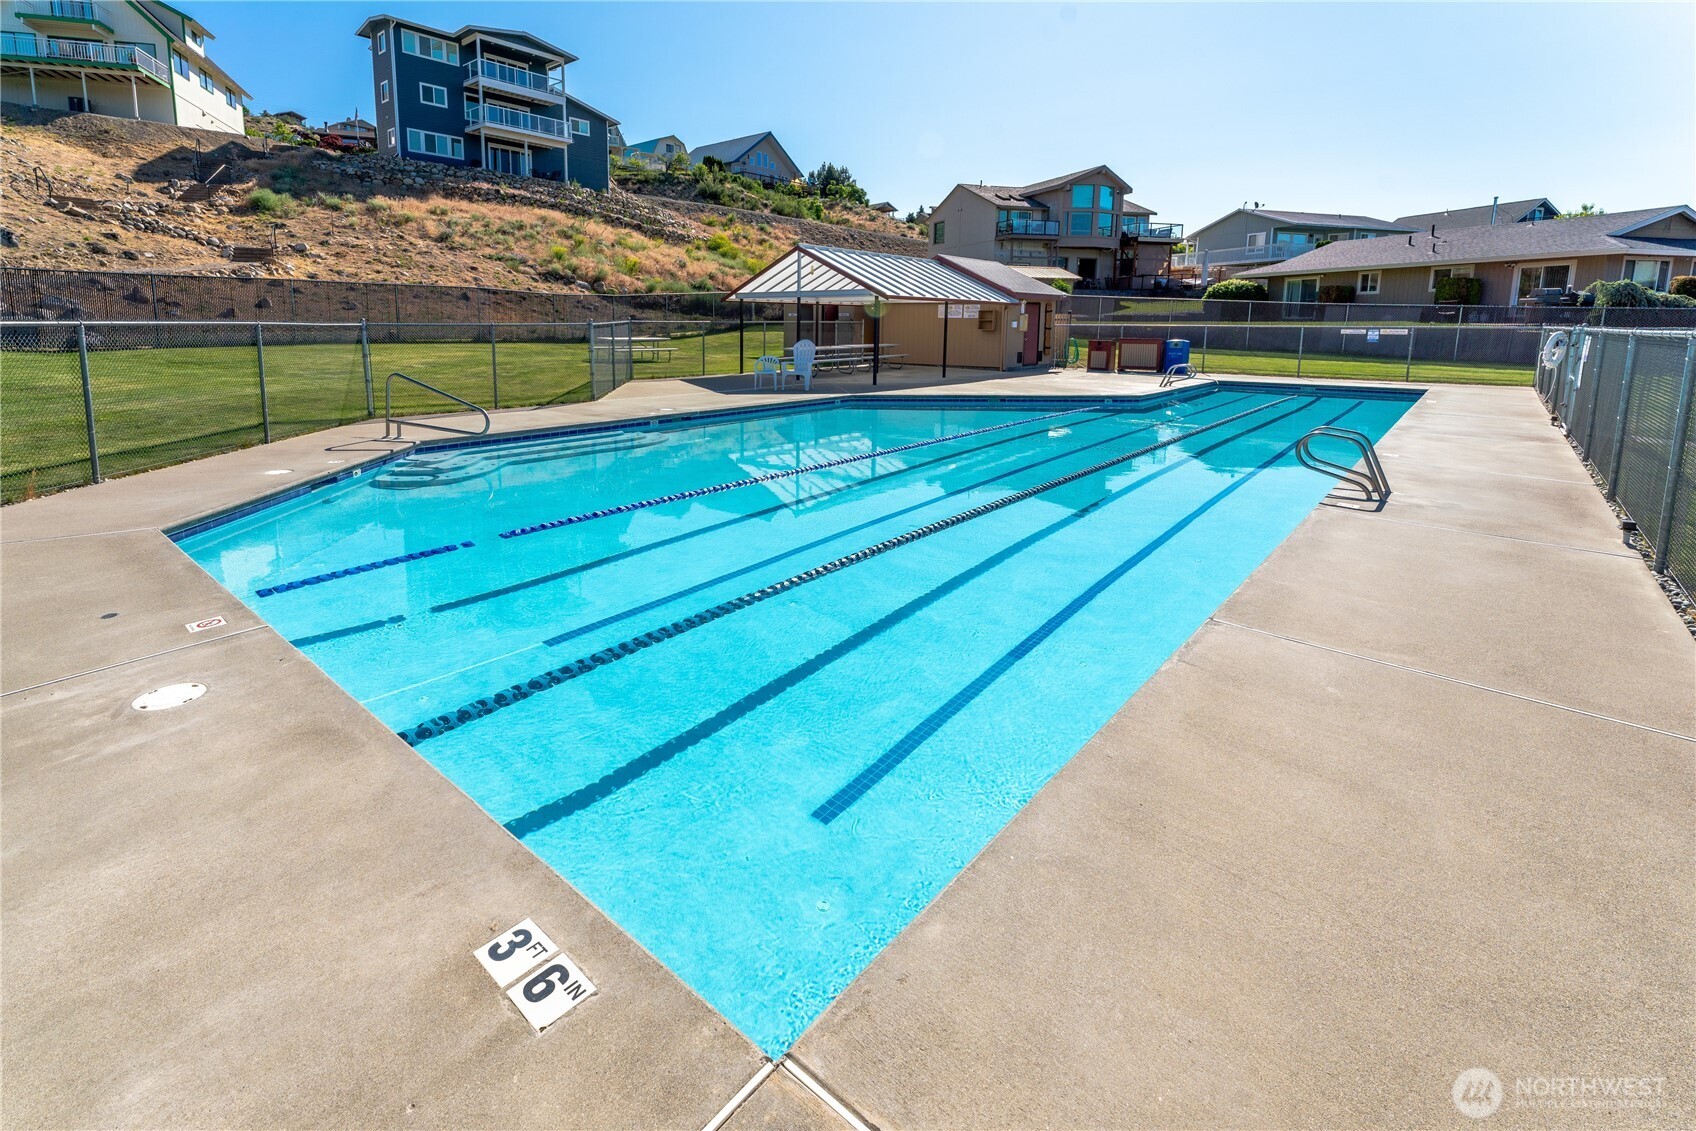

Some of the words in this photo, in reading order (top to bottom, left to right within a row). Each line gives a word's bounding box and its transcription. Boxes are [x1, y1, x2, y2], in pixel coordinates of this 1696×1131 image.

[488, 928, 533, 962] 3
[526, 941, 549, 959] FT
[522, 963, 570, 1003] 6
[563, 979, 587, 1001] IN
